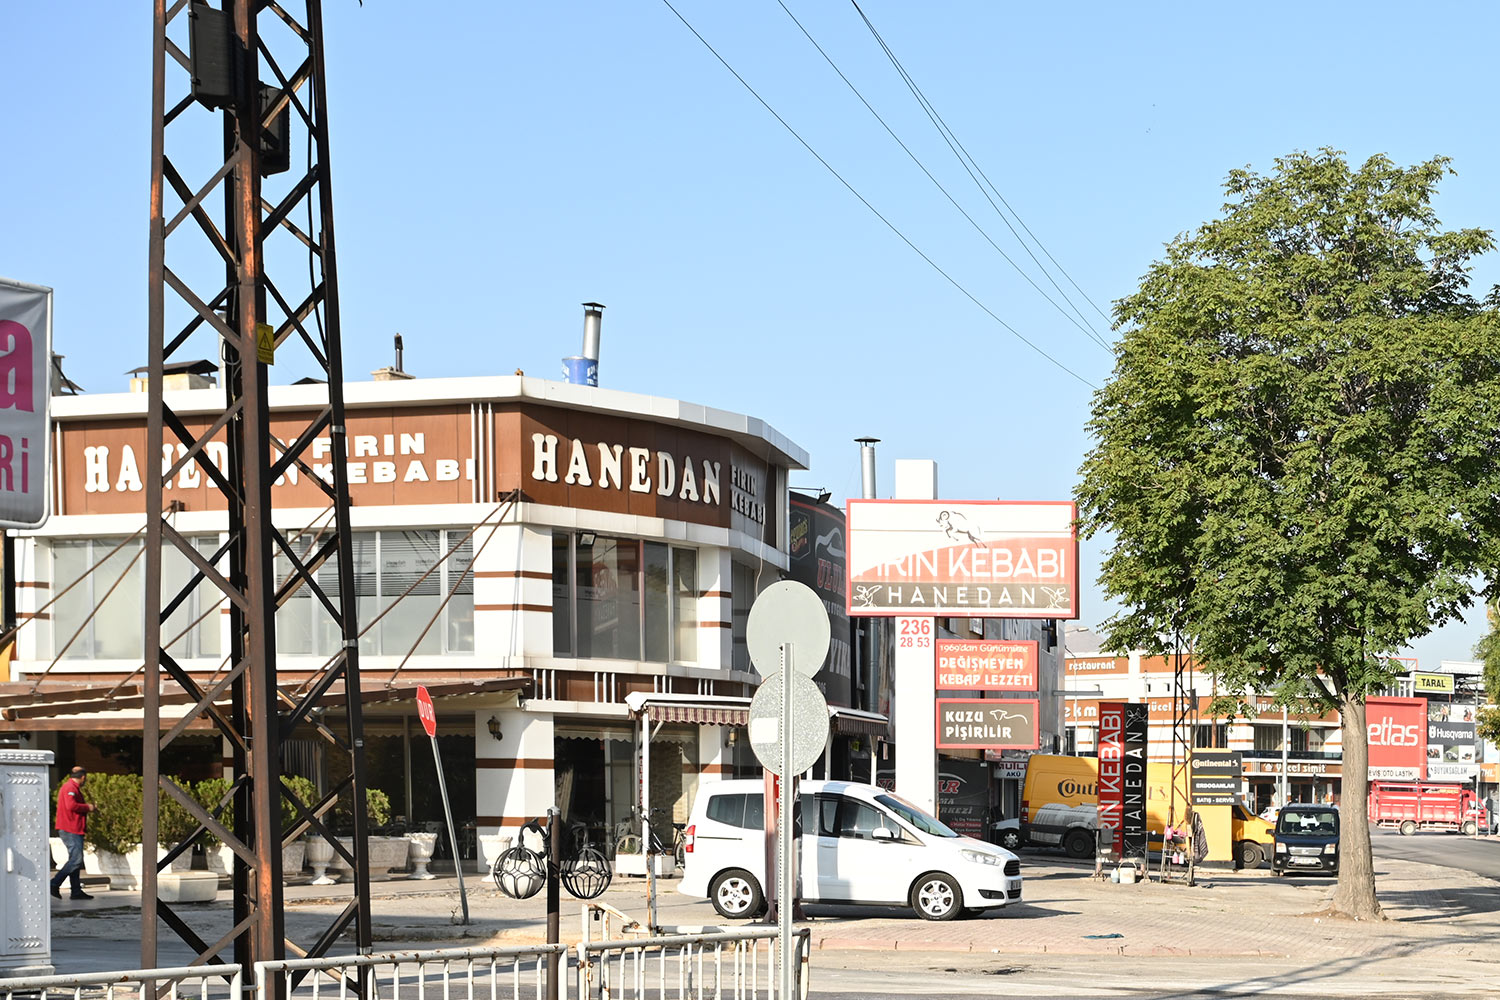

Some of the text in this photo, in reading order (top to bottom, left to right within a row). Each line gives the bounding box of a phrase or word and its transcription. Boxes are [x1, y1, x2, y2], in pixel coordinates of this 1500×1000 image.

[312, 432, 425, 458] FRIN
[531, 433, 722, 505] HANEDAN
[731, 464, 757, 497] FIRIN
[949, 548, 1065, 577] KEBABI
[888, 586, 1036, 605] HANEDAN
[900, 619, 930, 635] 236
[900, 637, 930, 648] 28 53
[940, 656, 1024, 671] DEĞİŞMEYEN
[1068, 661, 1116, 671] restaurant
[940, 673, 1033, 686] KEBAP LEZZETİ
[1421, 679, 1446, 688] TARAL
[417, 699, 435, 722] DUR
[945, 711, 984, 722] KUZU
[945, 725, 1012, 740] PİŞİRİLİR
[1437, 729, 1473, 740] Husqvarna
[1100, 710, 1121, 793] KEBABI
[1191, 759, 1232, 768] Continental
[1125, 732, 1143, 836] HANEDAN
